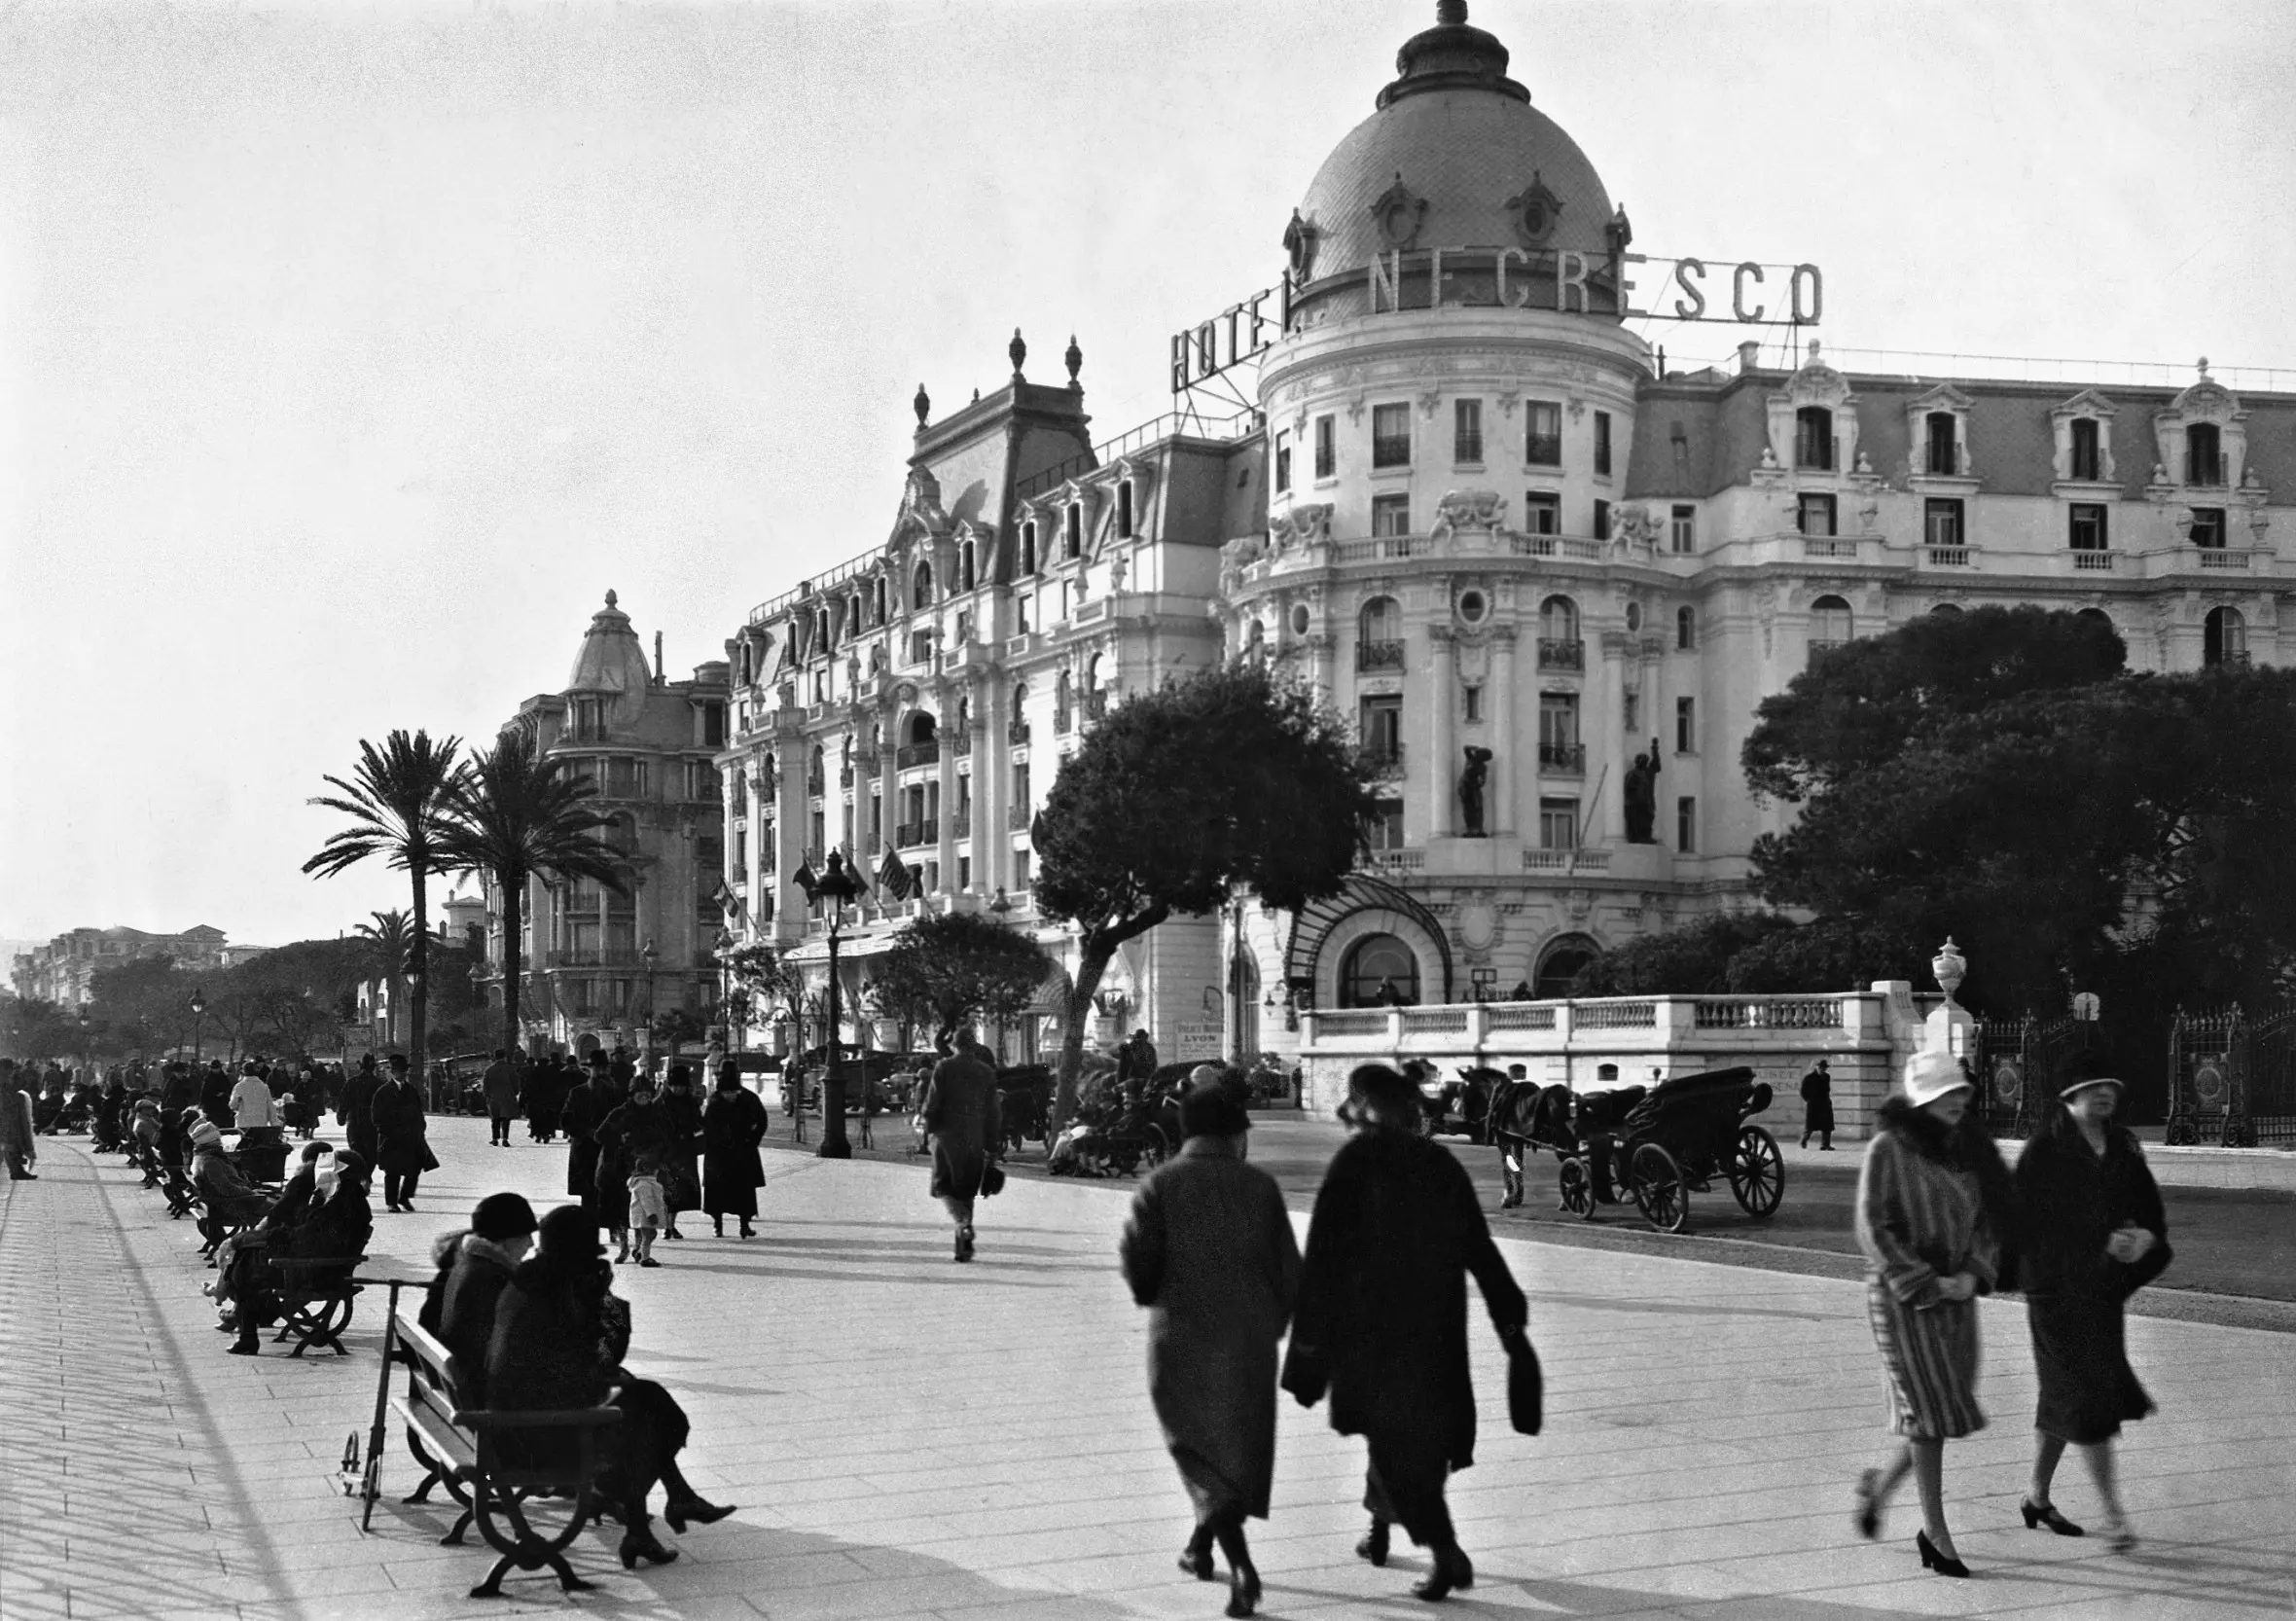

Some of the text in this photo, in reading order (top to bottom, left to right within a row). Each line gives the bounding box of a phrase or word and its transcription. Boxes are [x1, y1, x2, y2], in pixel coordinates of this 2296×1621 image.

[1171, 246, 1822, 393] HOTEL NEGRESCO
[1184, 1034, 1218, 1043] LYON
